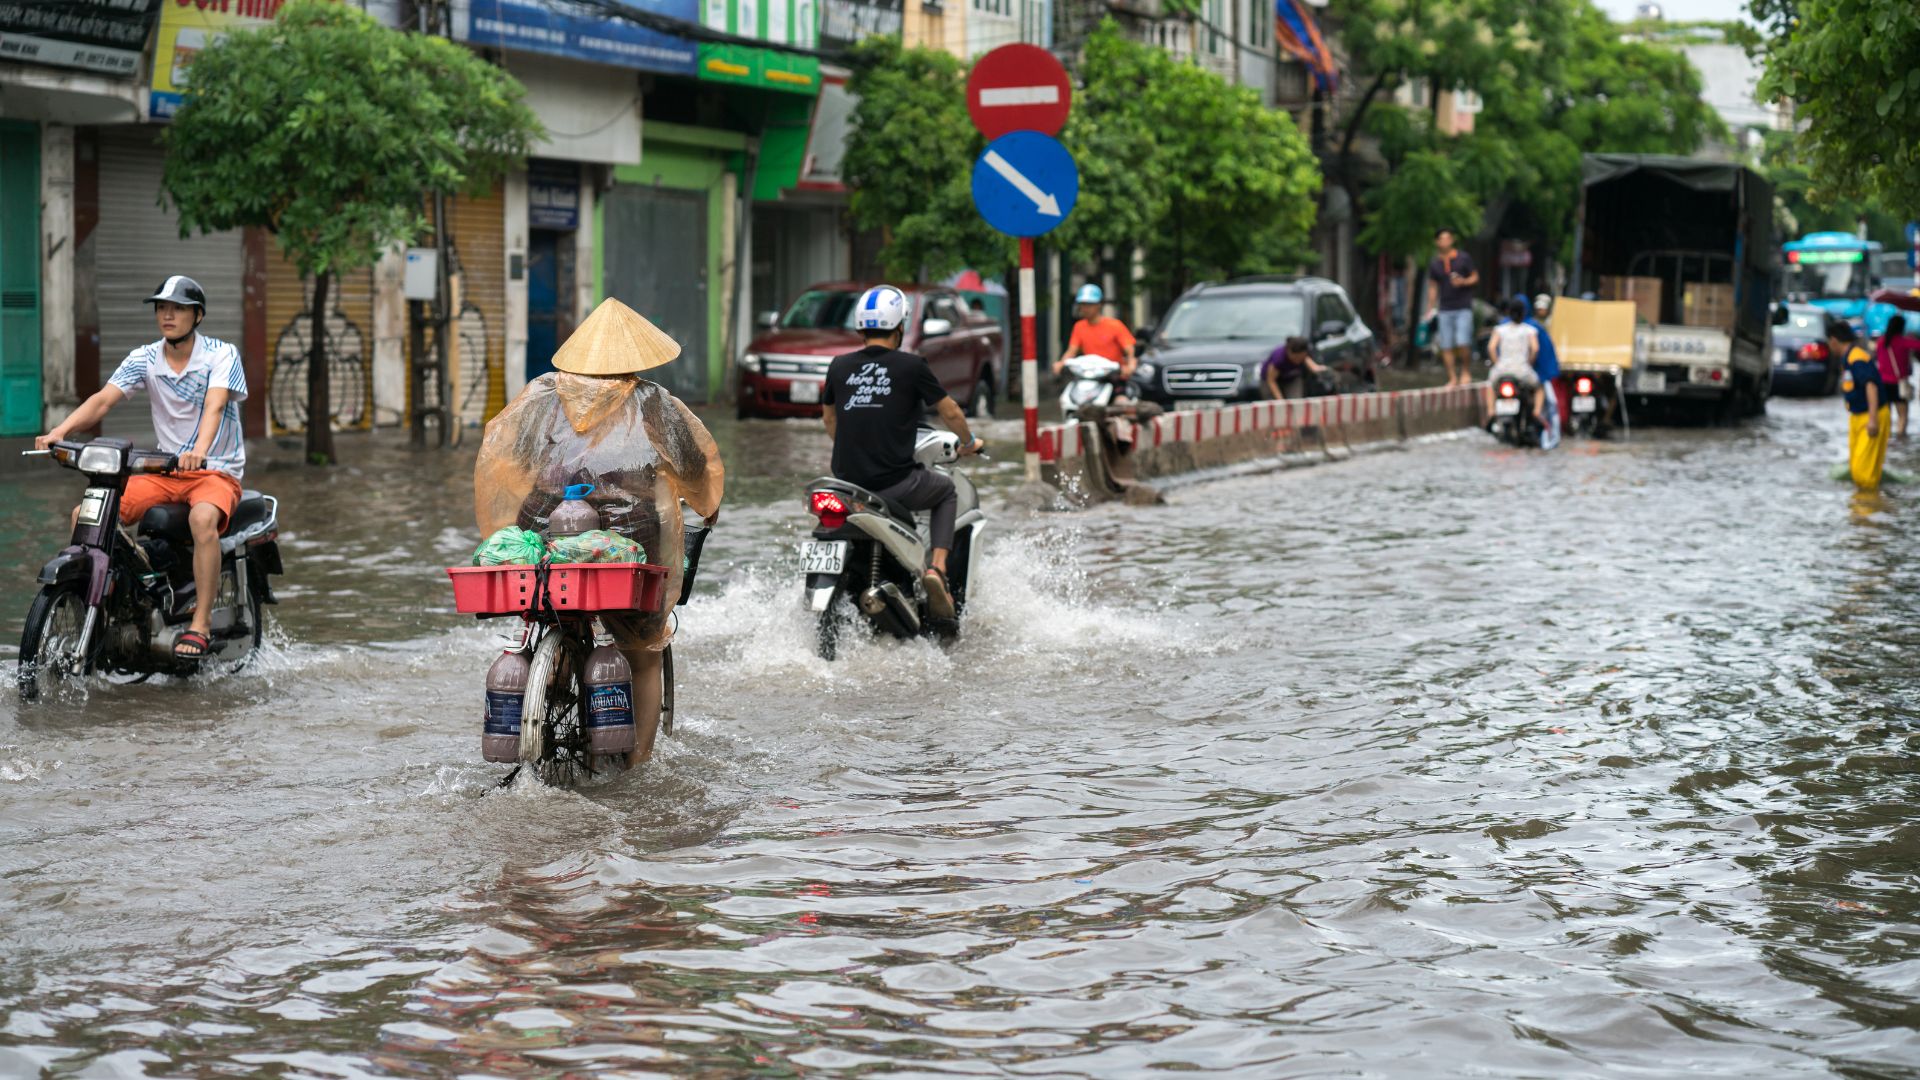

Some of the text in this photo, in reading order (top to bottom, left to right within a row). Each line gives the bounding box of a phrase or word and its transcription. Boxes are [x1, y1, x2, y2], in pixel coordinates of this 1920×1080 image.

[859, 363, 887, 376] I'm
[846, 373, 891, 386] here to
[856, 385, 891, 396] serve
[843, 395, 872, 410] you
[590, 692, 629, 711] AQUAFINA
